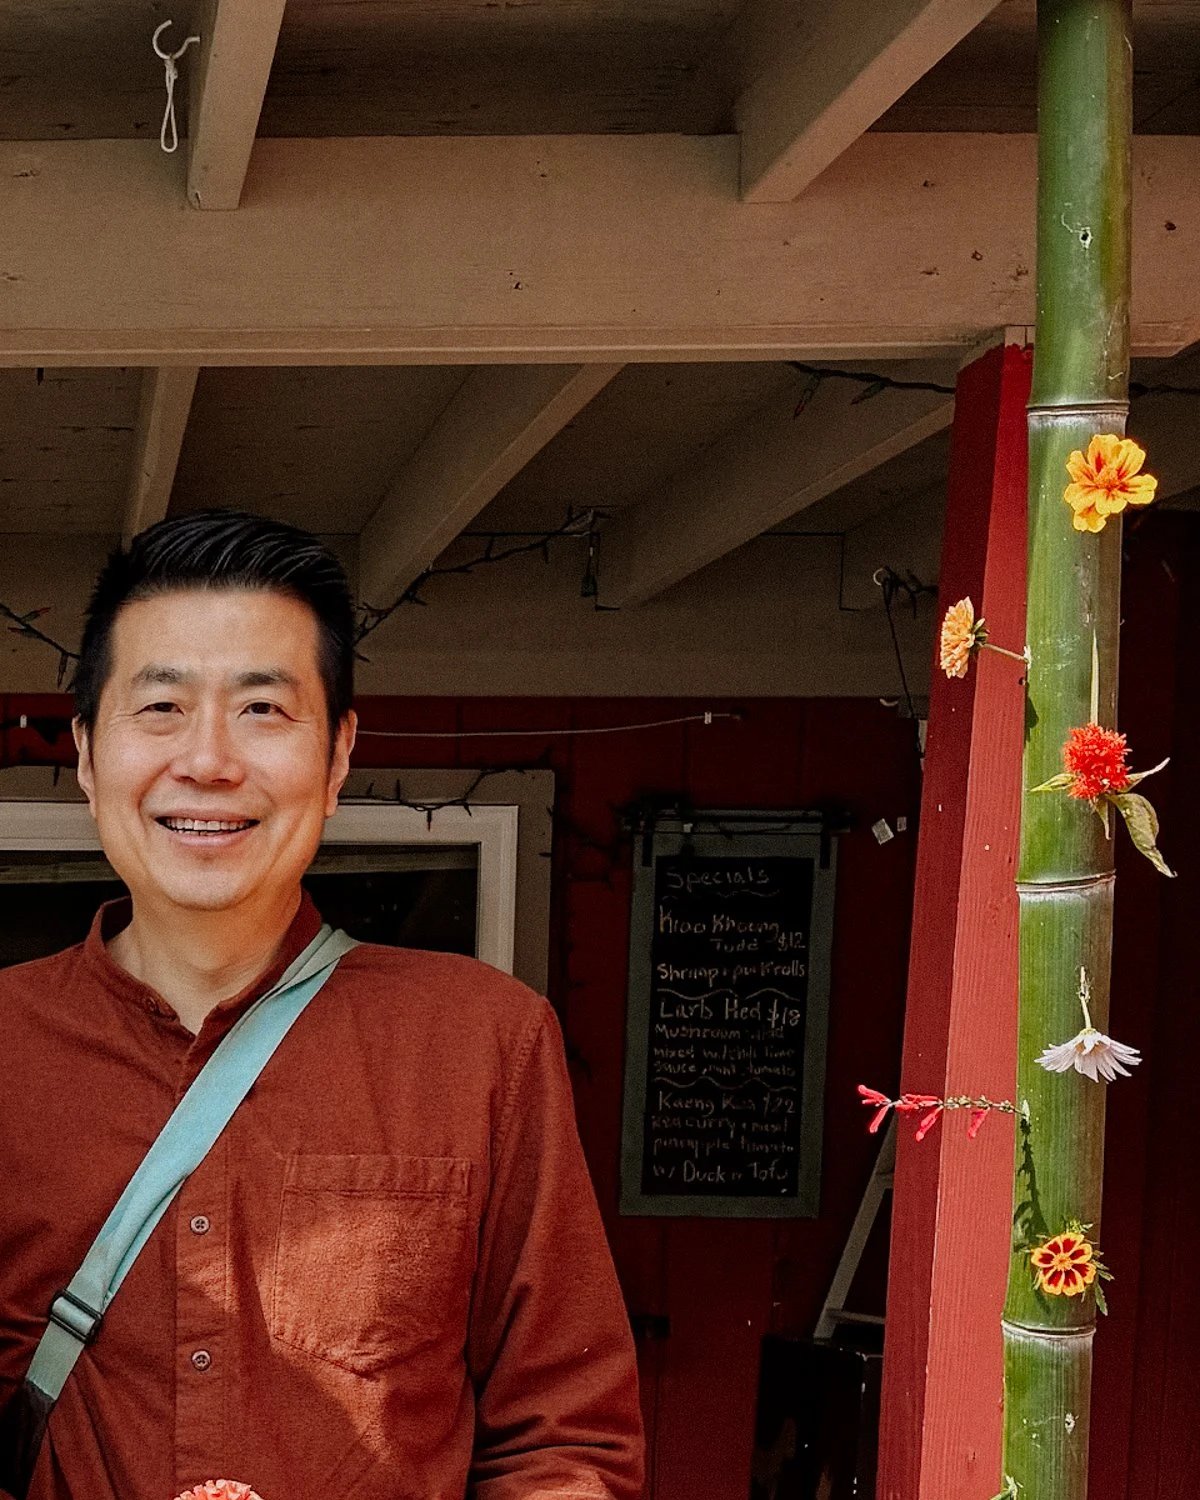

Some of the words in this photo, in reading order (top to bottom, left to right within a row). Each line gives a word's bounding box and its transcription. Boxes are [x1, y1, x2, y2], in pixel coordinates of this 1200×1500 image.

[666, 866, 770, 893] Specials
[777, 931, 807, 951] $12
[656, 962, 719, 988] Shrimp
[660, 998, 713, 1020] Larb
[767, 998, 801, 1028] $18
[654, 1023, 741, 1040] Mushroom
[683, 1159, 726, 1184] Duck
[747, 1157, 789, 1182] Tofu
